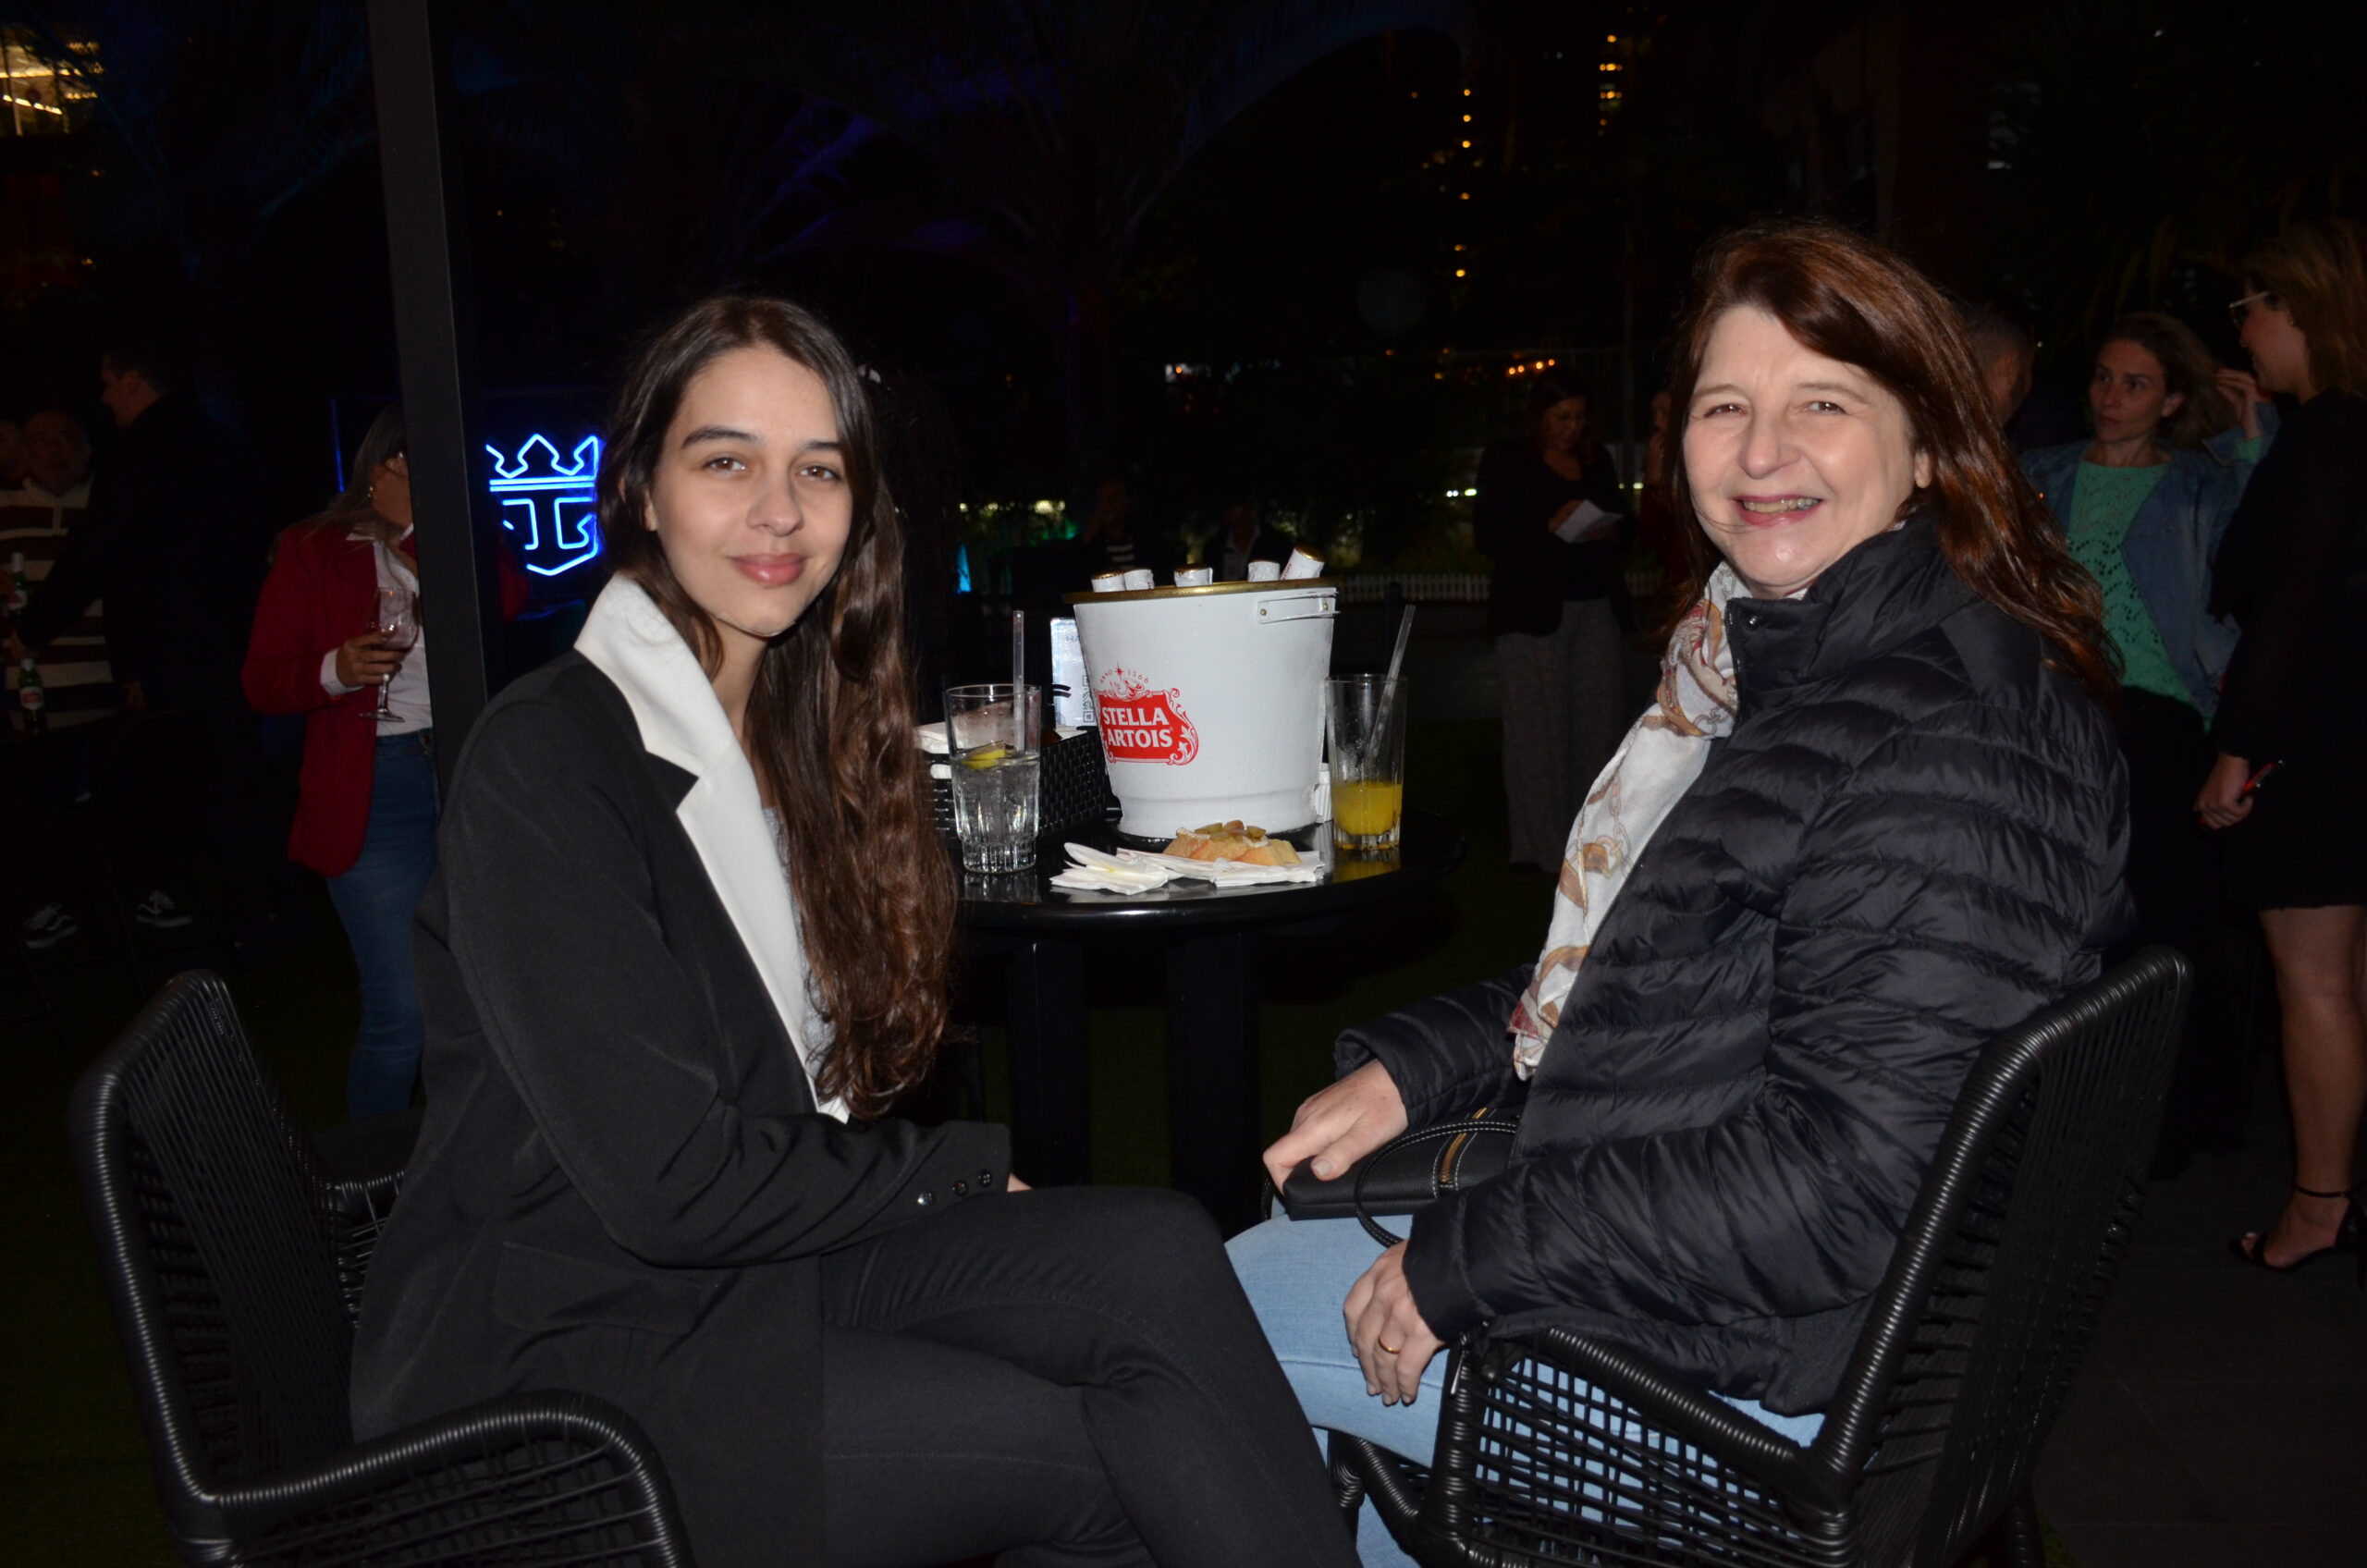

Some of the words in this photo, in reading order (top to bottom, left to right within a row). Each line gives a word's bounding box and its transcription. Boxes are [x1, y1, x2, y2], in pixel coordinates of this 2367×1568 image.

[1127, 668, 1150, 684] 1366
[1101, 706, 1170, 727] STELLA
[1107, 729, 1173, 748] ARTOIS
